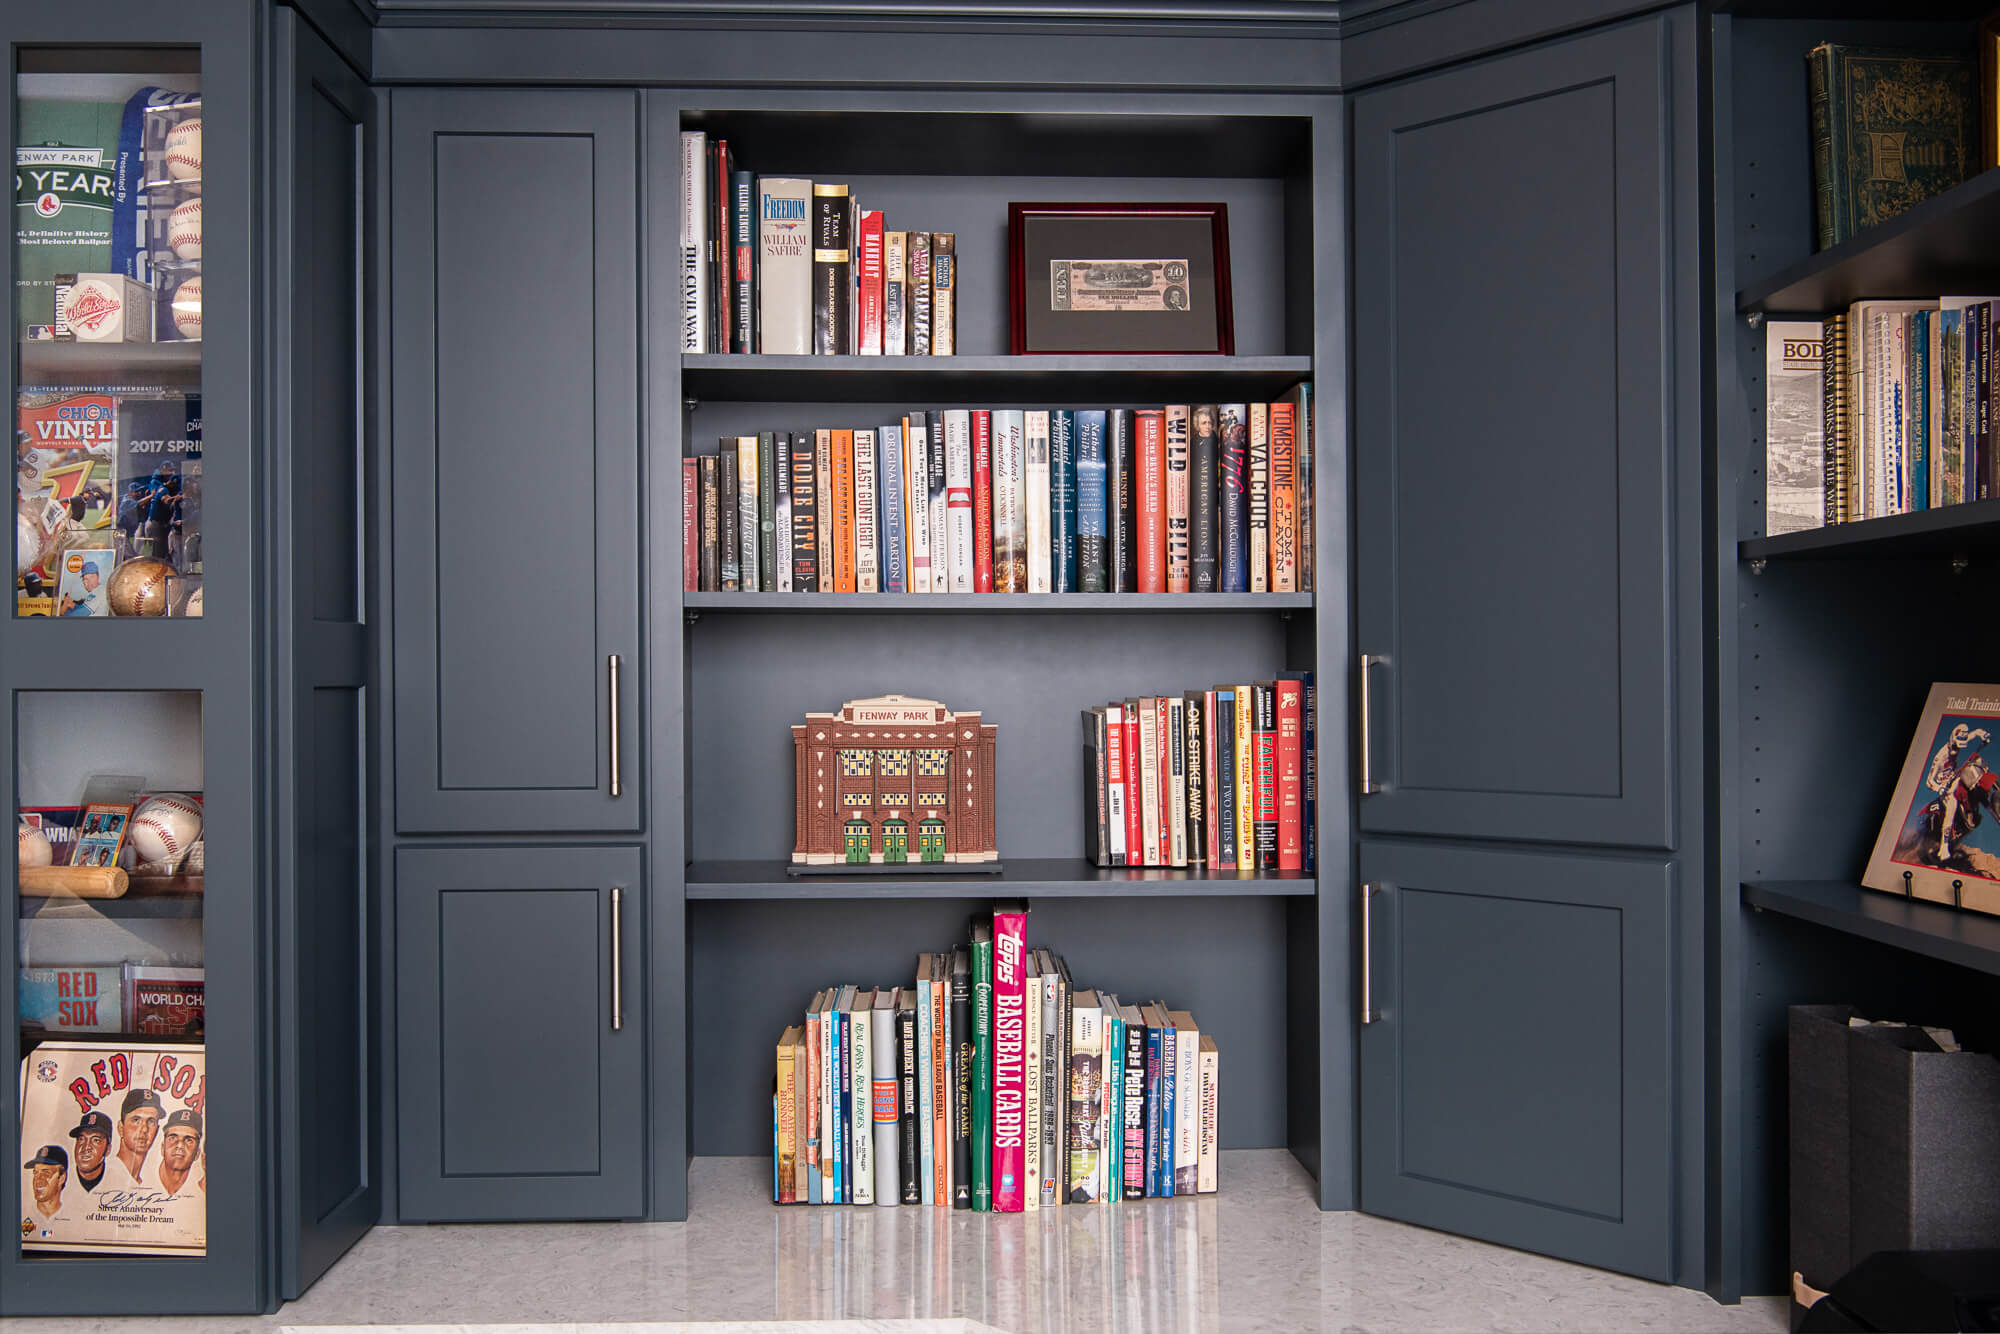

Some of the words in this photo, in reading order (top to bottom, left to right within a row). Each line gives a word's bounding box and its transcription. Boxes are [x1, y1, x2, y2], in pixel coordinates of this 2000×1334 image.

[62, 154, 96, 162] PARK
[120, 151, 128, 188] Presented
[116, 189, 126, 204] By
[738, 184, 749, 212] KILLING
[764, 194, 806, 219] FREEDOM
[824, 204, 830, 214] OF
[738, 214, 749, 242] LINCOLN
[764, 234, 807, 246] WILLIAM
[832, 212, 840, 238] TEAM
[686, 244, 696, 272] THE
[768, 246, 802, 256] SAFIRE
[865, 233, 880, 278] MANHUNT
[686, 275, 696, 312] CIVIL
[686, 312, 696, 349] WAR
[1980, 308, 1988, 330] Henry
[1980, 331, 1988, 352] David
[1824, 324, 1836, 391] NATIONAL
[58, 404, 113, 420] CHICA
[1825, 394, 1835, 434] PARKS
[1980, 400, 1988, 418] Cape
[933, 422, 942, 444] BRIAN
[980, 416, 988, 436] BRIAN
[1052, 418, 1060, 462] Philbrick
[1062, 417, 1072, 464] Nathaniel
[1916, 423, 1922, 436] MY
[1980, 419, 1988, 434] Cod
[129, 440, 162, 453] 2017
[168, 440, 202, 453] SPRI
[856, 434, 871, 460] THE
[888, 432, 896, 484] ORIGINAL
[934, 444, 943, 477] KILMEADE
[980, 437, 988, 468] KILMEADE
[997, 432, 1006, 478] Immortals
[1010, 426, 1020, 482] Washington's
[1168, 418, 1186, 472] WILD
[1273, 408, 1292, 491] TOMBSTONE
[1825, 437, 1835, 455] OF
[793, 452, 813, 506] DODGE
[838, 457, 846, 474] THE
[857, 462, 872, 490] LAST
[1221, 446, 1245, 494] 1776
[1825, 457, 1835, 486] THE
[838, 476, 846, 496] LAST
[1200, 458, 1208, 516] AMERICAN
[1250, 443, 1266, 530] VALCOUR
[739, 458, 758, 558] Mayflower
[838, 500, 848, 526] STAND
[889, 488, 898, 528] INTENT
[1228, 492, 1238, 517] DAVID
[1825, 488, 1836, 526] WEST
[794, 515, 814, 550] CITY
[858, 492, 874, 550] GUNFIGHT
[1200, 520, 1208, 547] LION
[1274, 496, 1284, 574] CLAVIN
[1284, 511, 1292, 557] TOM
[1082, 514, 1090, 568] AMBITION
[1168, 518, 1188, 565] BILL
[890, 536, 900, 578] BARTON
[860, 712, 898, 720] FENWAY
[904, 712, 928, 720] PARK
[1946, 697, 1970, 710] Total
[1188, 708, 1200, 736] ONE
[1188, 739, 1201, 786] STRIKE
[1258, 736, 1273, 818] FAITHFUL
[1190, 788, 1201, 822] AWAY
[1224, 784, 1232, 808] TWO
[1224, 810, 1232, 841] CITIES
[58, 972, 97, 998] RED
[140, 993, 183, 1006] WORLD
[58, 1000, 98, 1026] SOX
[976, 982, 992, 1035] COOPERSTOWN
[856, 1022, 865, 1042] REAL
[904, 1022, 914, 1038] DAVE
[919, 1004, 928, 1056] COACHING
[996, 994, 1022, 1086] BASEBALL
[904, 1040, 914, 1075] DRAVECKY
[1044, 1034, 1054, 1058] Phoenix
[1164, 1034, 1175, 1077] BASEBALL
[1184, 1050, 1192, 1072] BOYS
[960, 1042, 969, 1083] GREATS
[1044, 1059, 1054, 1074] Suns
[1184, 1072, 1192, 1083] OF
[70, 1053, 129, 1113] RED
[856, 1075, 865, 1094] REAL
[920, 1059, 930, 1104] WINNING
[960, 1084, 969, 1092] of
[1028, 1064, 1038, 1094] LOST
[1044, 1075, 1054, 1106] Basketball
[1126, 1069, 1144, 1096] Pete
[904, 1077, 914, 1114] COMEBACK
[936, 1084, 944, 1120] BASEBALL
[960, 1094, 970, 1106] the
[1110, 1082, 1118, 1114] League
[1163, 1078, 1174, 1113] Letters
[1183, 1084, 1192, 1120] SUMMER
[780, 1090, 788, 1134] RUNNER
[856, 1096, 865, 1129] HEROES
[961, 1106, 970, 1138] GAME
[994, 1090, 1022, 1148] CARDS
[1126, 1096, 1144, 1128] Rose:
[1208, 1119, 1214, 1128] OF
[921, 1106, 932, 1158] BASEBALL
[1028, 1098, 1038, 1164] BALLPARKS
[1078, 1118, 1090, 1145] Ruth
[1126, 1128, 1143, 1148] MY
[1082, 1148, 1090, 1168] BUILT
[1126, 1150, 1144, 1187] STORY
[86, 1213, 96, 1222] of
[96, 1214, 107, 1222] the
[108, 1214, 148, 1223] Impossible
[149, 1216, 174, 1224] Dream
[120, 1204, 164, 1214] Anniversary
